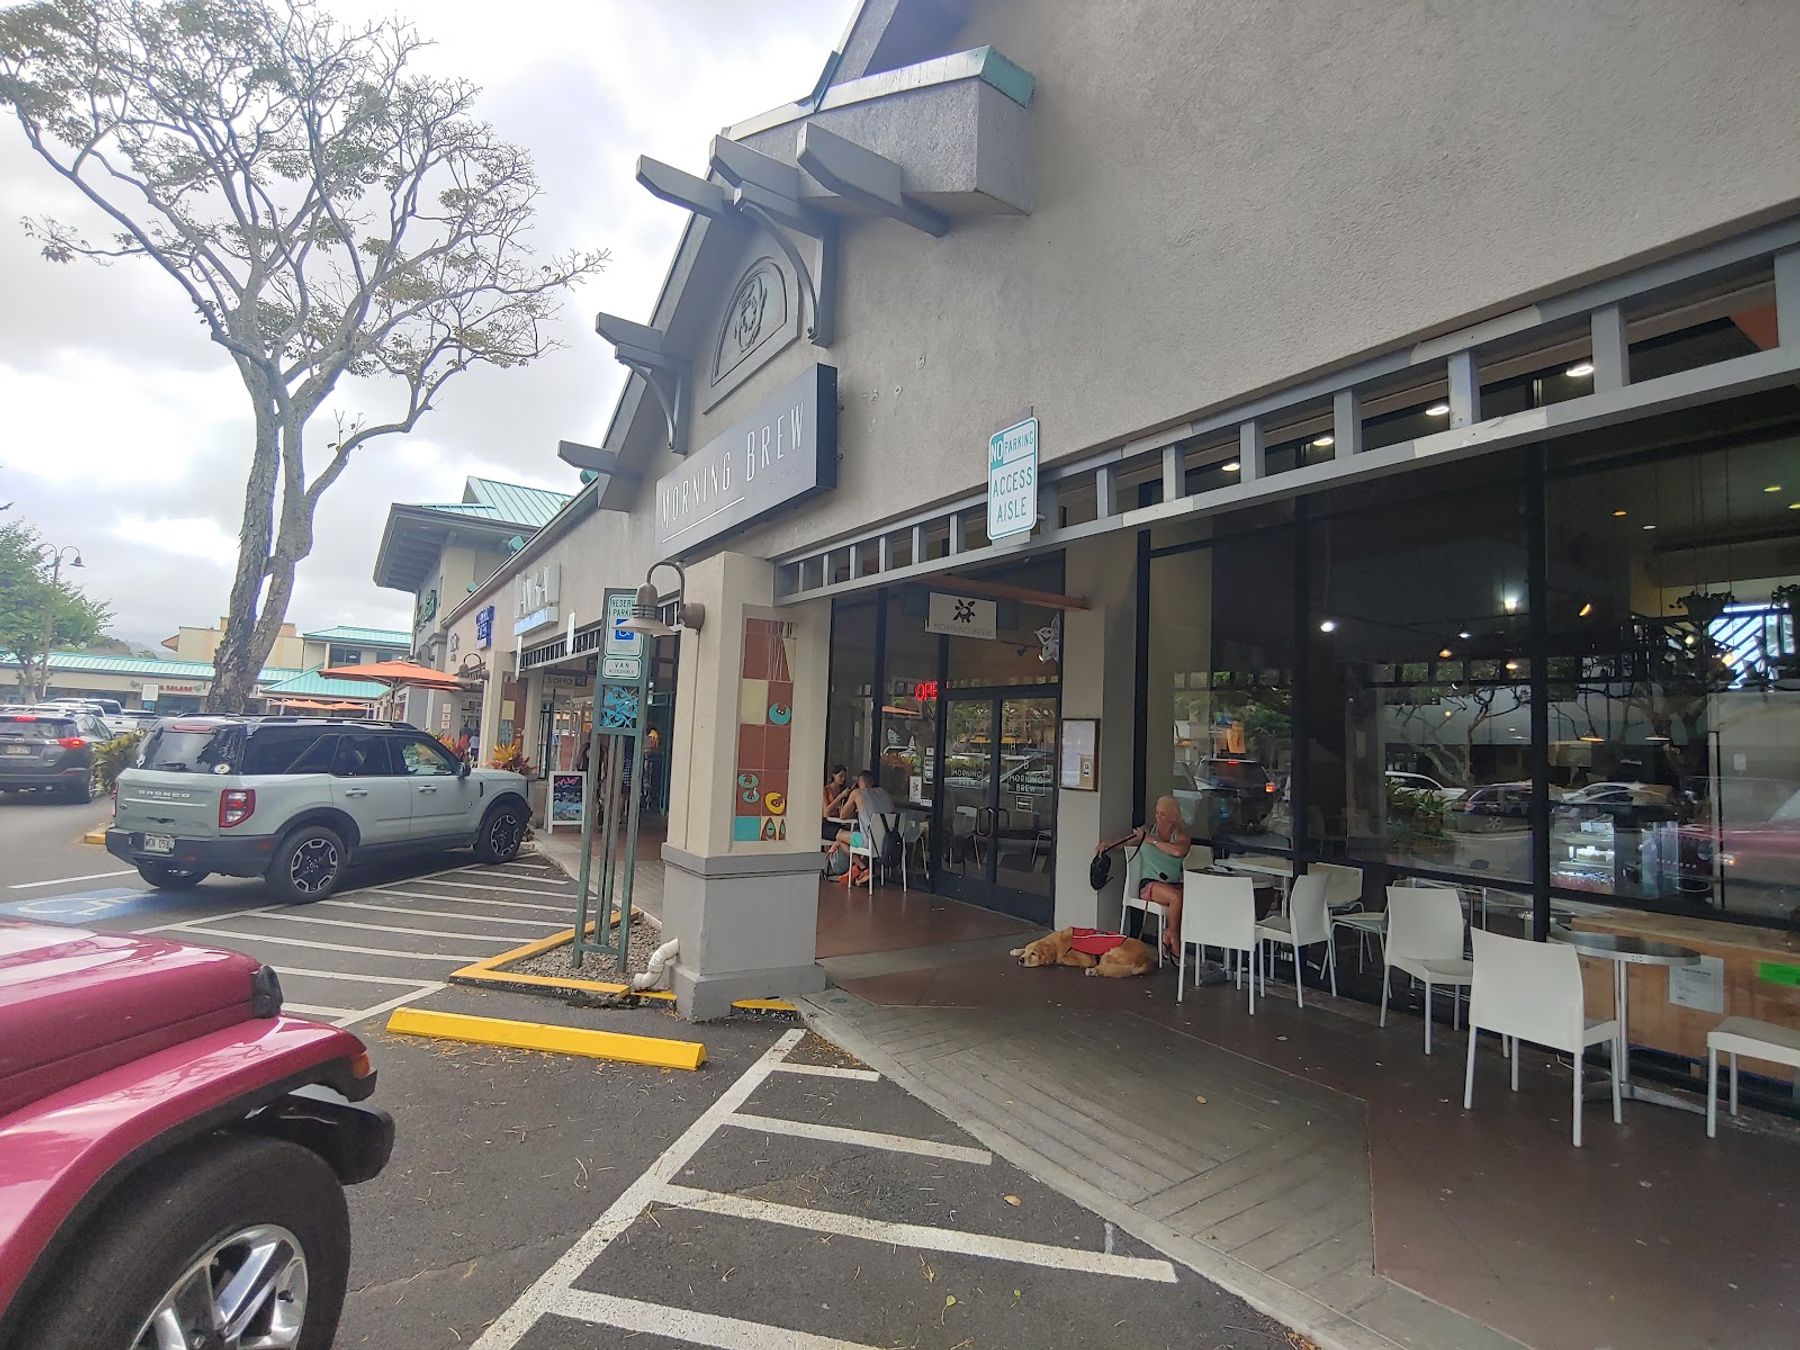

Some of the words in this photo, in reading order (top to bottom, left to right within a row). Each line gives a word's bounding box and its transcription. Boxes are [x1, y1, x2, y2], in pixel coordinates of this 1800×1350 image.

[991, 440, 1004, 463] NO
[1005, 431, 1034, 454] PARKING
[661, 451, 731, 529] MORNING
[746, 402, 803, 482] BREW
[993, 466, 1032, 498] ACCESS
[997, 497, 1027, 524] AISLE
[611, 599, 636, 608] RESERV
[914, 681, 938, 701] OPE
[1009, 774, 1043, 784] MORNING
[1016, 783, 1036, 793] BREW
[138, 789, 191, 798] BRONCO
